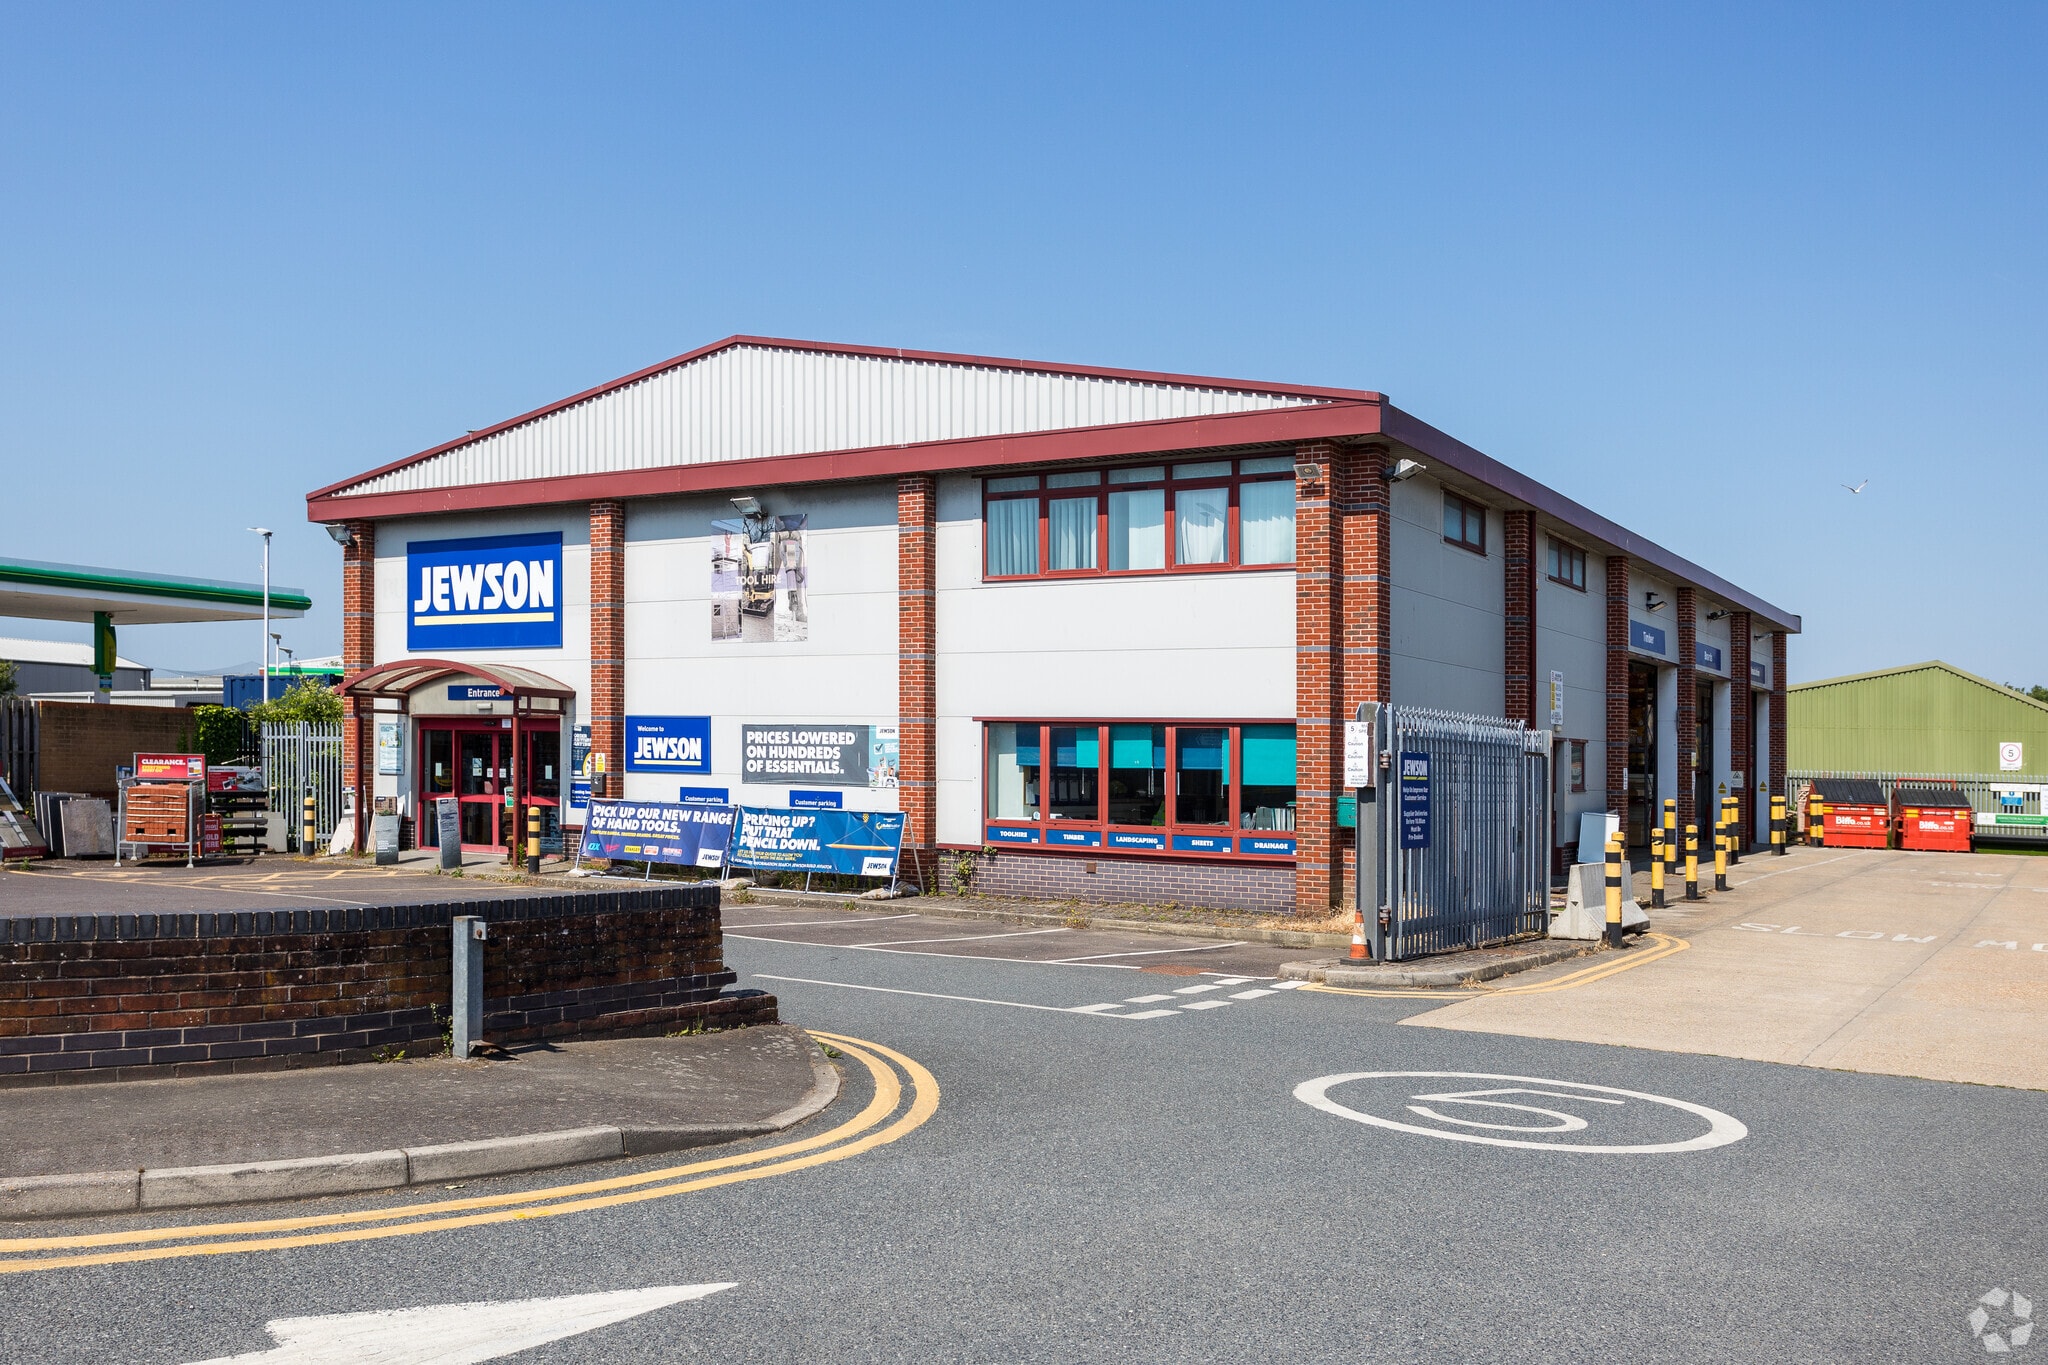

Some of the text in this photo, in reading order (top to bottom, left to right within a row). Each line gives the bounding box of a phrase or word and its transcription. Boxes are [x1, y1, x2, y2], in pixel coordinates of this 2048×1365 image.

[414, 559, 554, 613] JEWSON
[735, 574, 782, 585] TOOL HIRE
[467, 688, 500, 697] Entrance
[746, 731, 856, 745] PRICES LOWERED
[633, 736, 702, 760] JEWSON
[746, 745, 841, 760] ON HUNDREDS
[2008, 749, 2014, 758] 5
[746, 759, 845, 774] OF ESSENTIALS.
[1403, 759, 1428, 776] JEWSON
[817, 800, 837, 808] parking
[592, 805, 733, 825] PICK UP OUR NEW RANGE
[742, 813, 816, 827] PRICING UP?
[591, 816, 681, 834] OF HAND TOOLS.
[741, 825, 795, 839] PUT THAT
[999, 830, 1028, 838] TOOLHIRE
[1062, 833, 1085, 841] TIMBER
[587, 842, 601, 851] OX
[739, 838, 821, 851] PENCIL DOWN.
[1115, 836, 1159, 844] LANDSCAPING
[1191, 839, 1214, 847] SHEETS
[1254, 842, 1289, 850] DRAINAGE
[1731, 922, 1938, 944] SLOW
